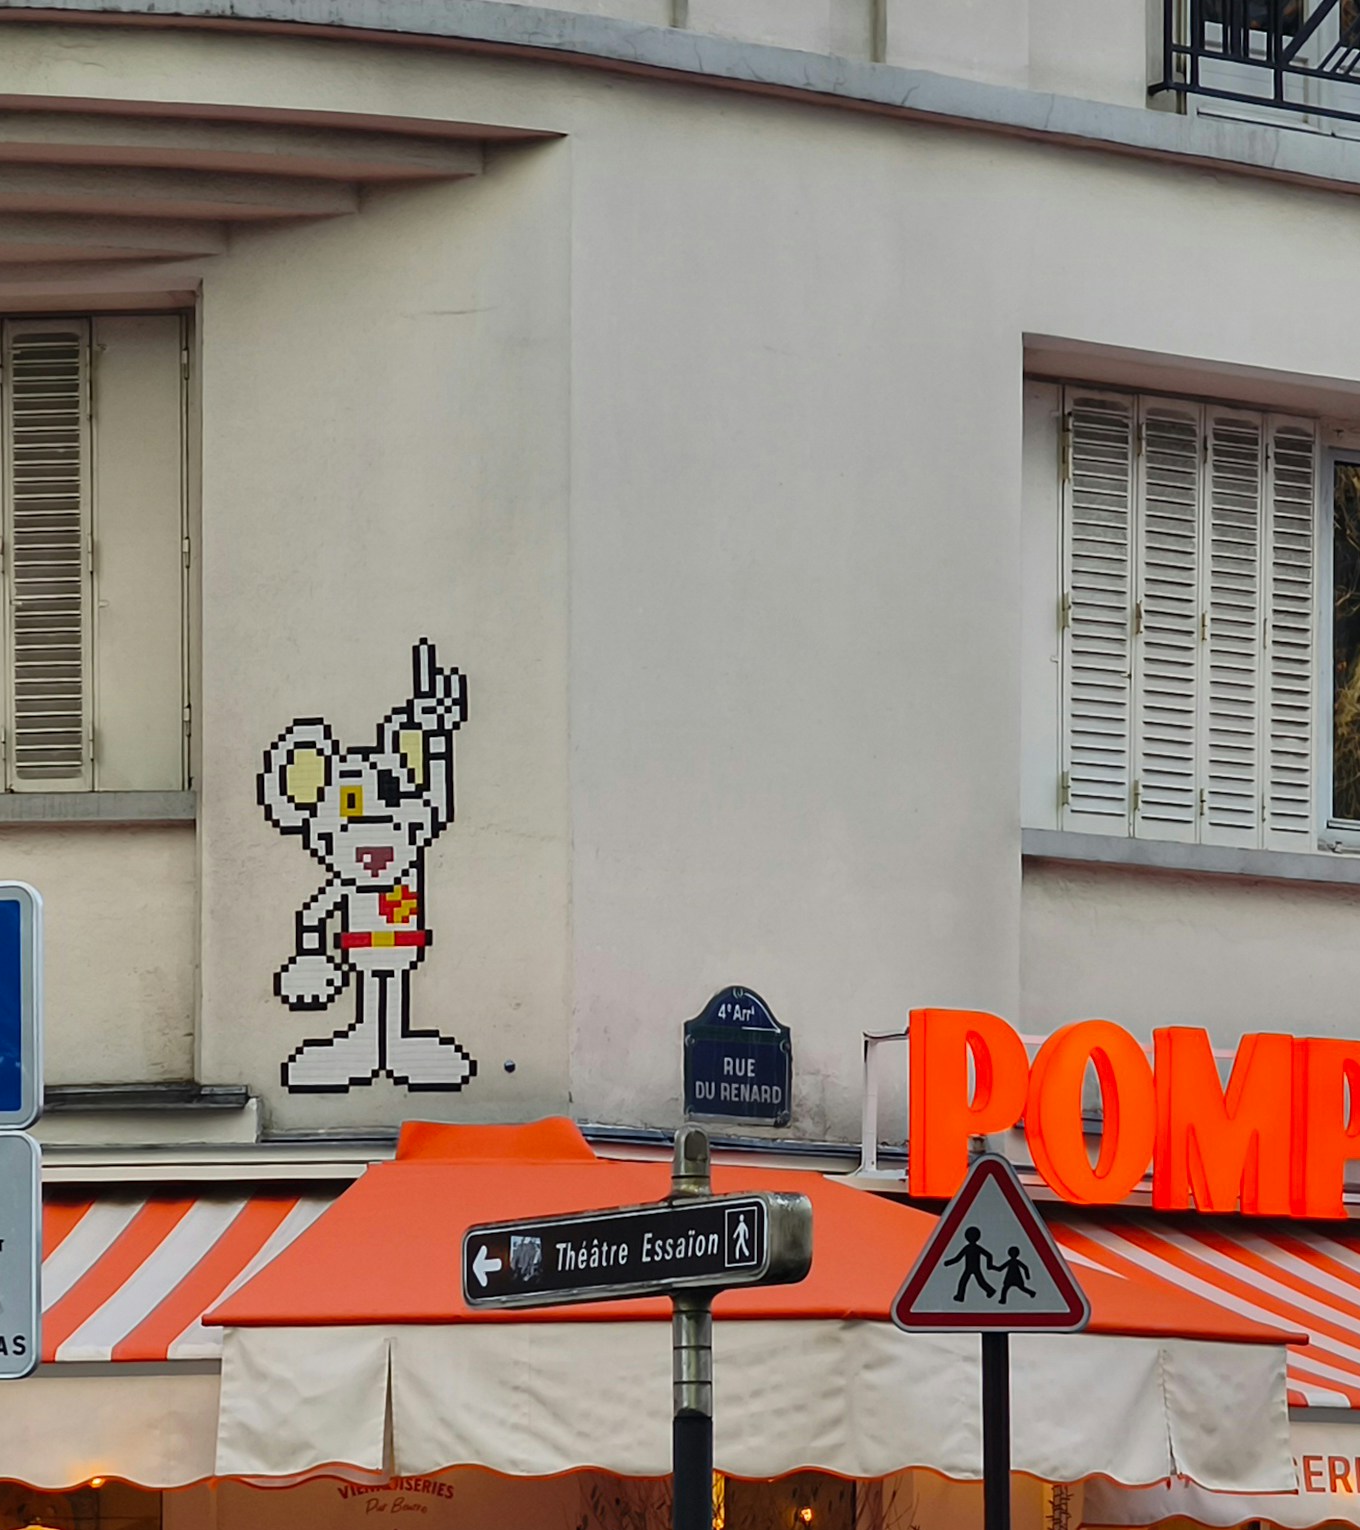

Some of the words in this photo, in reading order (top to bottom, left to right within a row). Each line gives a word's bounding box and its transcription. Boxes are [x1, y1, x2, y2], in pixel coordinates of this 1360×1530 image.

[723, 1057, 756, 1077] RUE
[695, 1080, 715, 1100] DU
[720, 1082, 782, 1105] RENARD
[555, 1238, 629, 1272] Théâtre
[641, 1230, 720, 1263] Essaïon
